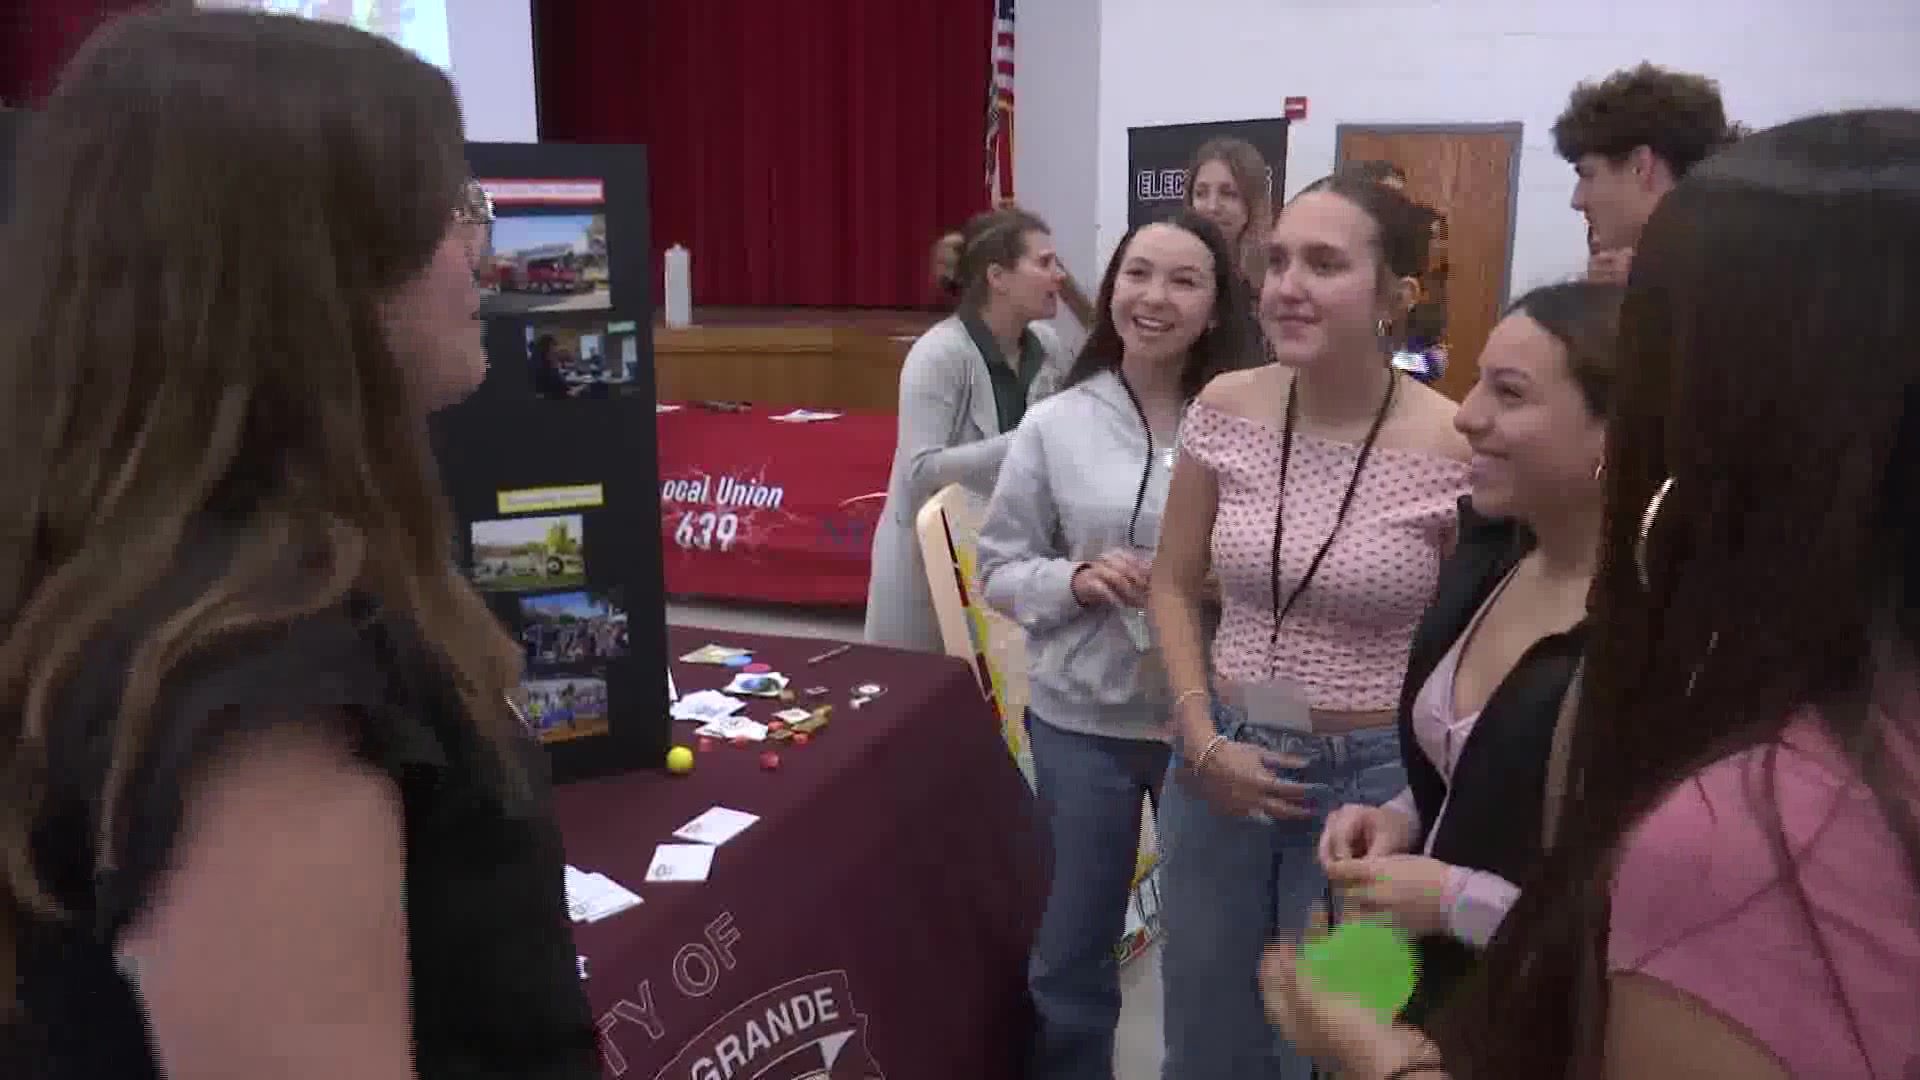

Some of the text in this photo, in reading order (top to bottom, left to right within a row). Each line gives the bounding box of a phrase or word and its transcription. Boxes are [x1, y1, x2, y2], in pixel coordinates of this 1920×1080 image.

[716, 475, 784, 510] Union
[675, 512, 739, 552] 639
[672, 911, 741, 996] OF
[690, 987, 840, 1080] GRANDE
